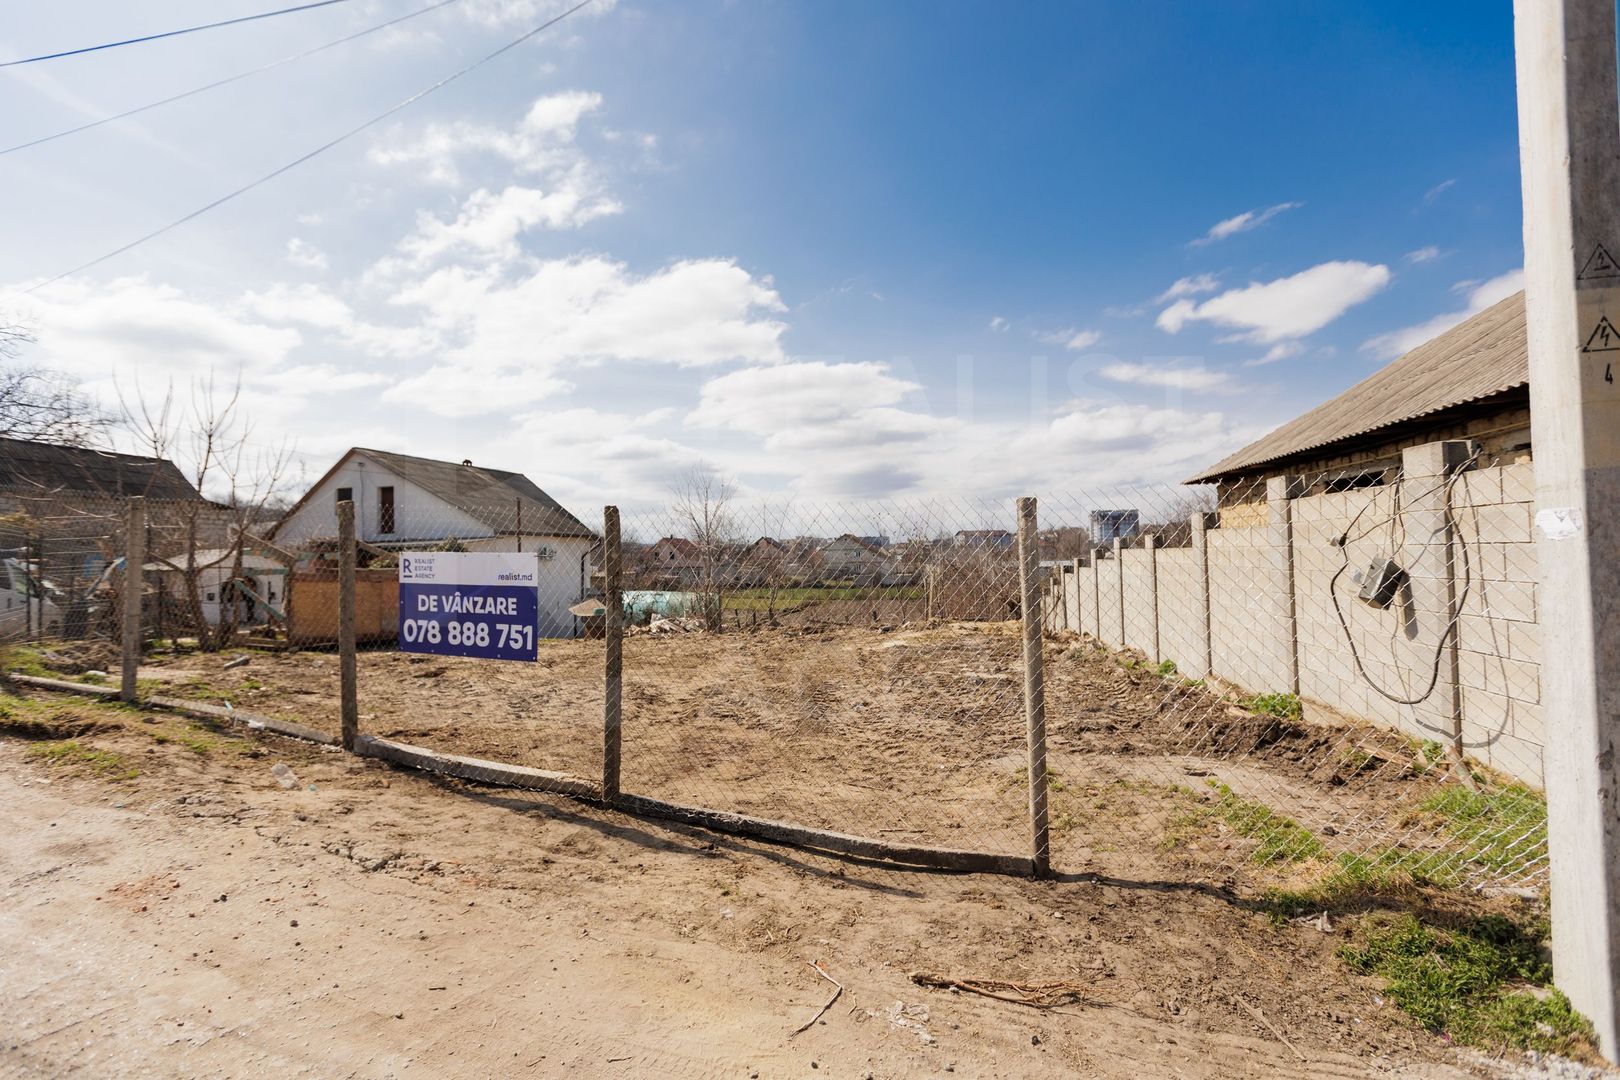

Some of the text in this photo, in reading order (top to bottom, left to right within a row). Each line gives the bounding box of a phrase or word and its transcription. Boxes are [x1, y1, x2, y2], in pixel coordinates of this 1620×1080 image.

[403, 558, 412, 573] R
[498, 573, 533, 581] realist.md
[417, 591, 518, 616] DE VÂNZARE
[403, 618, 533, 650] 078 888 751
